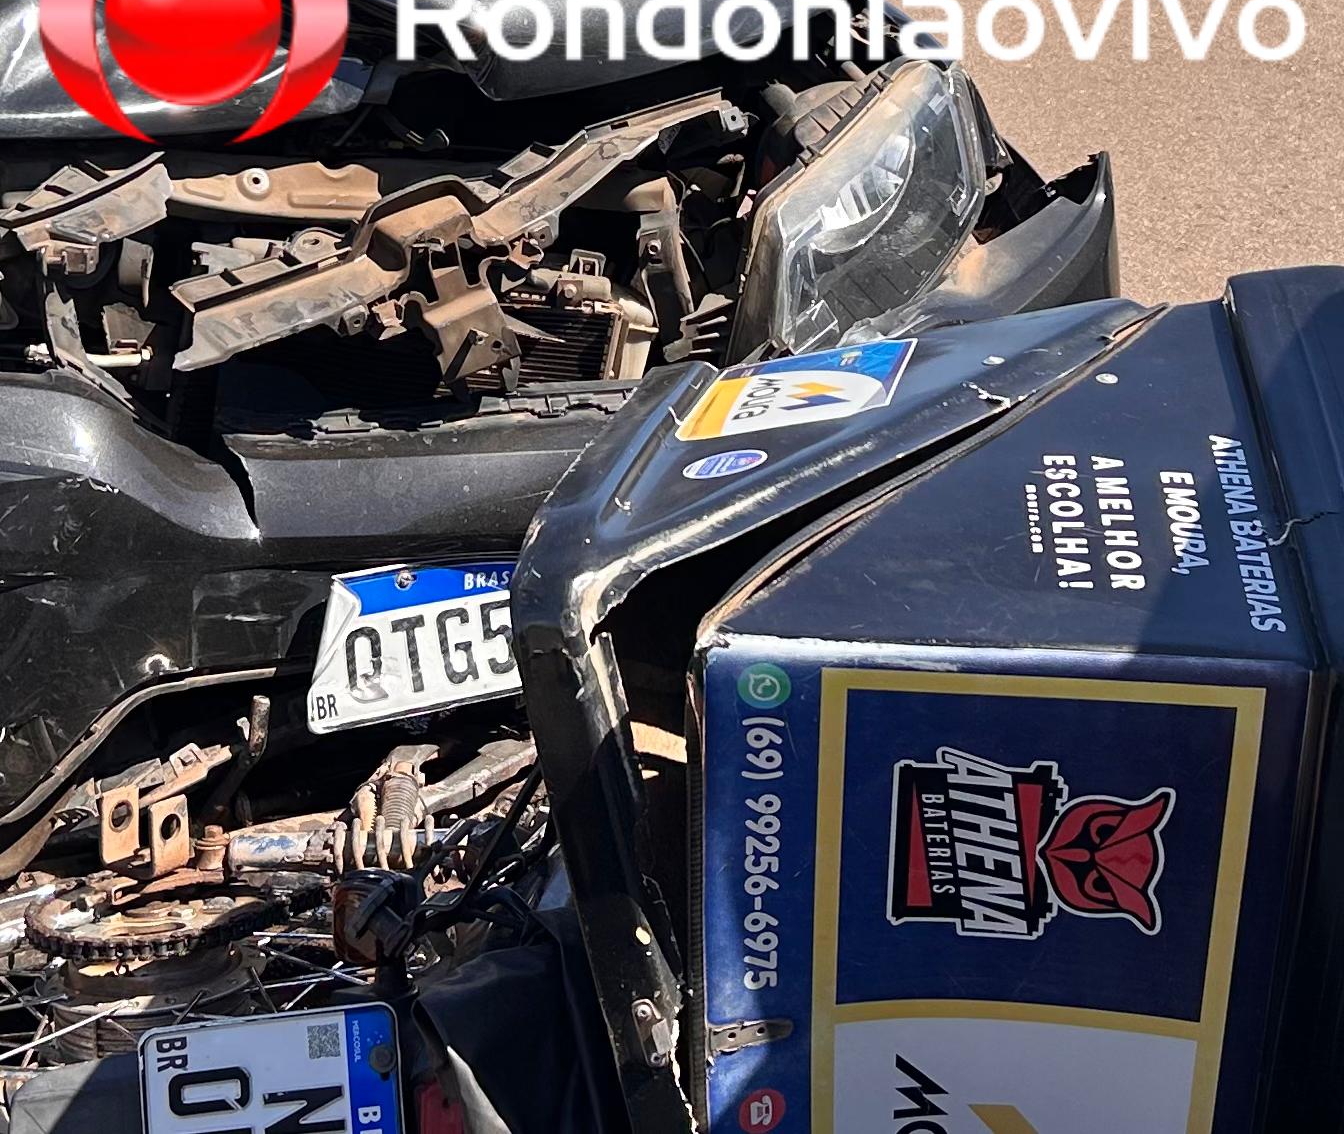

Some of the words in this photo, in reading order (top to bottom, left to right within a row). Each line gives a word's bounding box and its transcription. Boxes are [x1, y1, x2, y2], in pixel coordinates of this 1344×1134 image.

[1090, 455, 1125, 471] A
[1209, 434, 1258, 515] ATHENA
[1024, 484, 1044, 554] moura.com
[1042, 454, 1094, 590] ESCOLHA!
[1094, 477, 1146, 591] MELHOR
[1229, 519, 1287, 633] BATERIAS
[316, 694, 338, 719] BR
[741, 717, 785, 780] (69)
[921, 793, 956, 894] BATERIAS
[943, 752, 1028, 934] ATHENA
[743, 793, 783, 990] 99256-6975
[156, 1036, 188, 1072] BR
[352, 1019, 362, 1063] MERCOSUL
